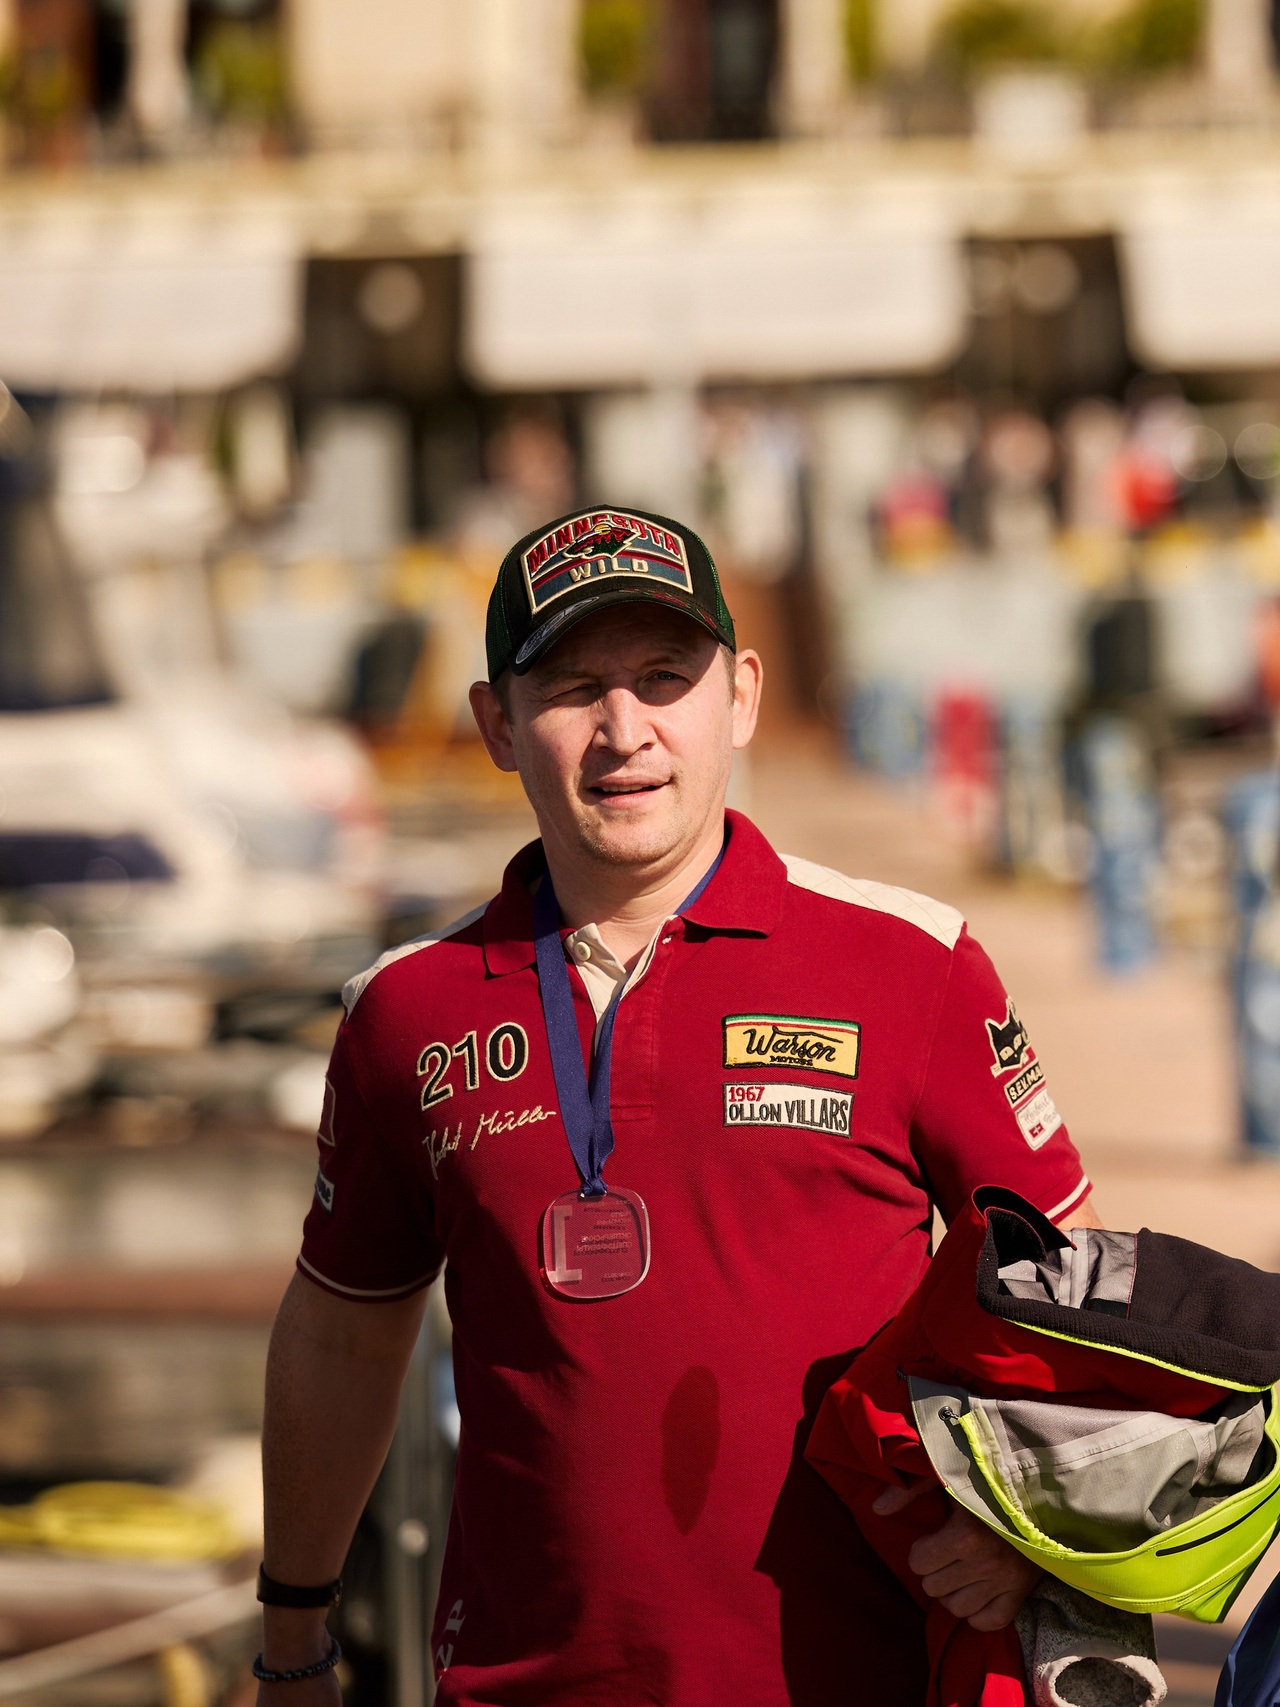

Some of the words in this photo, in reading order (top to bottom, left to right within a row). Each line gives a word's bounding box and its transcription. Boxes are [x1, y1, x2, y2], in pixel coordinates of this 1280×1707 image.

[569, 557, 649, 583] WILD
[742, 1025, 844, 1063] Warson
[416, 1021, 529, 1112] 210
[728, 1086, 765, 1102] 1967
[728, 1103, 782, 1122] OLLON
[784, 1097, 849, 1132] VILLARS
